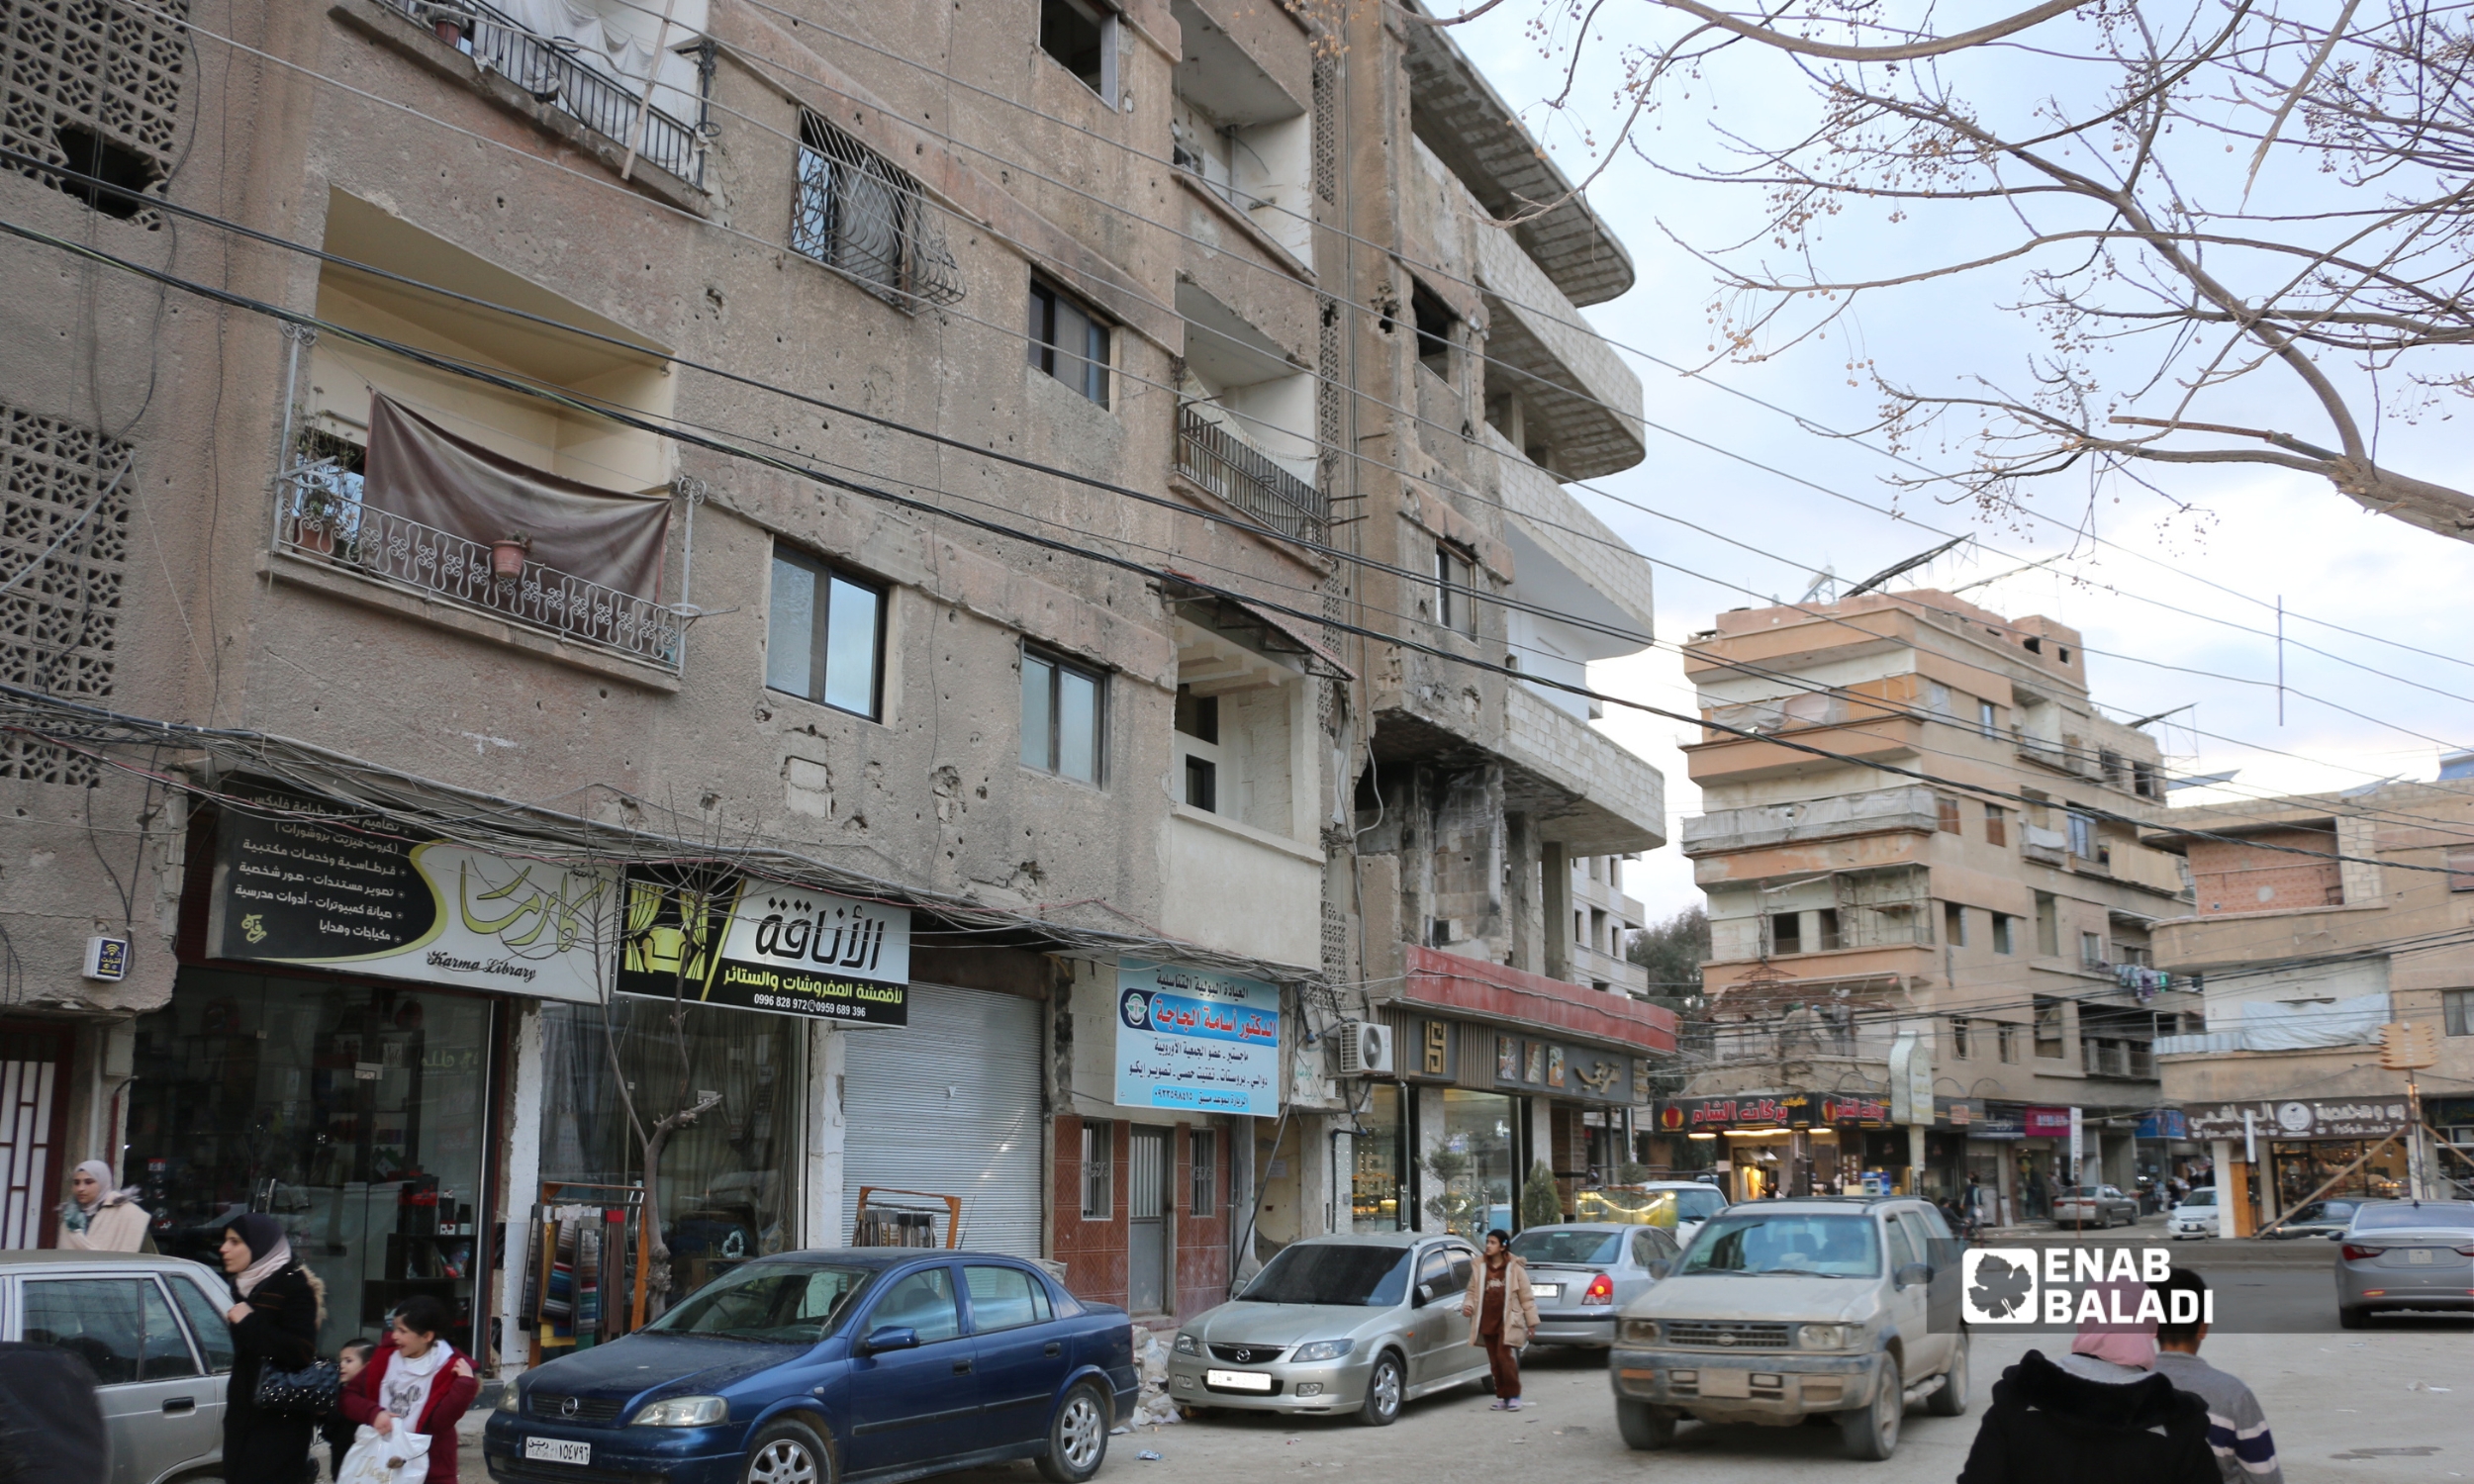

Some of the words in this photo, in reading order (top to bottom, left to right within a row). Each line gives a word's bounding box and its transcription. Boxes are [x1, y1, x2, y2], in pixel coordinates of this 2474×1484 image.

[242, 838, 288, 856] مكتبية
[290, 850, 335, 867] وخدمات
[337, 857, 396, 876] قرطاسية
[238, 862, 281, 878] شخصية
[281, 871, 305, 882] صور
[235, 884, 274, 898] مدرسية
[313, 875, 363, 891] مستندات
[364, 885, 395, 898] تصوير
[276, 891, 309, 904] أدوات
[315, 897, 364, 914] كمبيوترات
[366, 904, 393, 920] صيانة
[319, 918, 350, 936] وهدايا
[353, 926, 391, 941] مكياجات
[755, 896, 886, 972] الأناقة
[427, 950, 481, 970] Karma
[482, 958, 536, 983] Library
[722, 965, 779, 992] والستائر
[783, 974, 853, 998] المفروشات
[1156, 969, 1192, 990] التناسلية
[1194, 975, 1222, 997] البولية
[856, 982, 903, 1004] لأقمشة
[1223, 981, 1248, 1001] العيادة
[754, 993, 775, 1006] 0996
[776, 995, 791, 1008] 828
[793, 996, 808, 1010] 972
[816, 999, 835, 1014] 0959
[836, 1002, 851, 1015] 689
[852, 1004, 866, 1018] 396
[1204, 1005, 1238, 1032] أسامة
[1238, 1013, 1278, 1040] الدكتور
[1183, 1040, 1206, 1060] الجمعية
[1207, 1045, 1221, 1062] عضو
[1226, 1047, 1249, 1065] ماجستير
[1691, 1100, 1738, 1125] الشام
[1740, 1098, 1788, 1125] بركات
